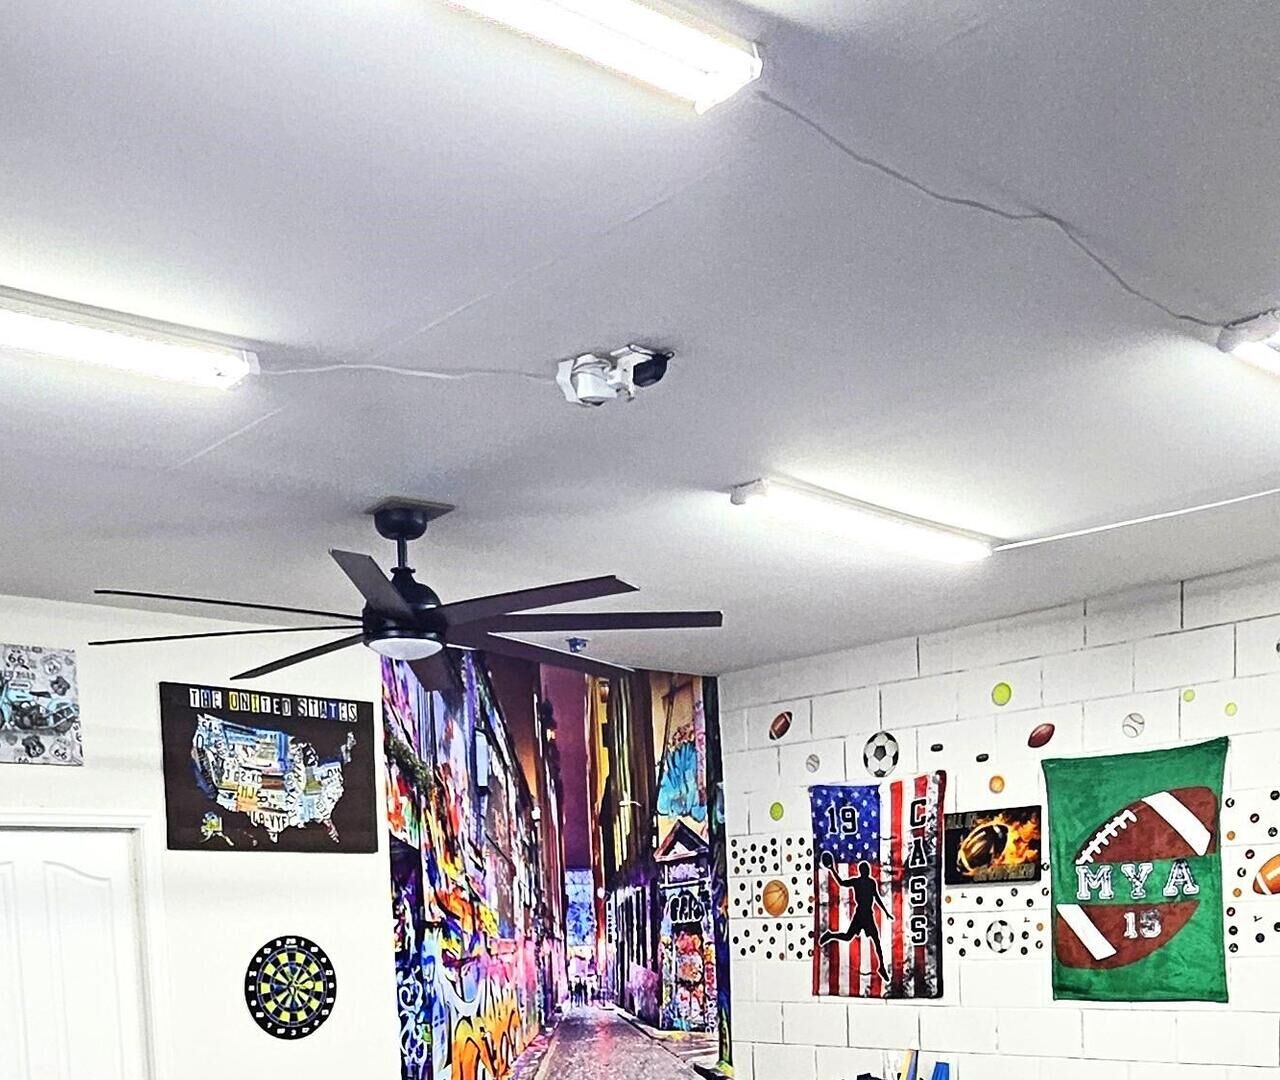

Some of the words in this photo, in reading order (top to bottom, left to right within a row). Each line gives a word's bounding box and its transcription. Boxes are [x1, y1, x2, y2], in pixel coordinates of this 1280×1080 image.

[8, 653, 25, 664] 66
[190, 688, 222, 709] THE
[229, 691, 292, 717] UNITED
[297, 697, 358, 723] STATES
[827, 803, 859, 835] 19
[1075, 858, 1200, 900] MYA
[1123, 909, 1162, 939] 15
